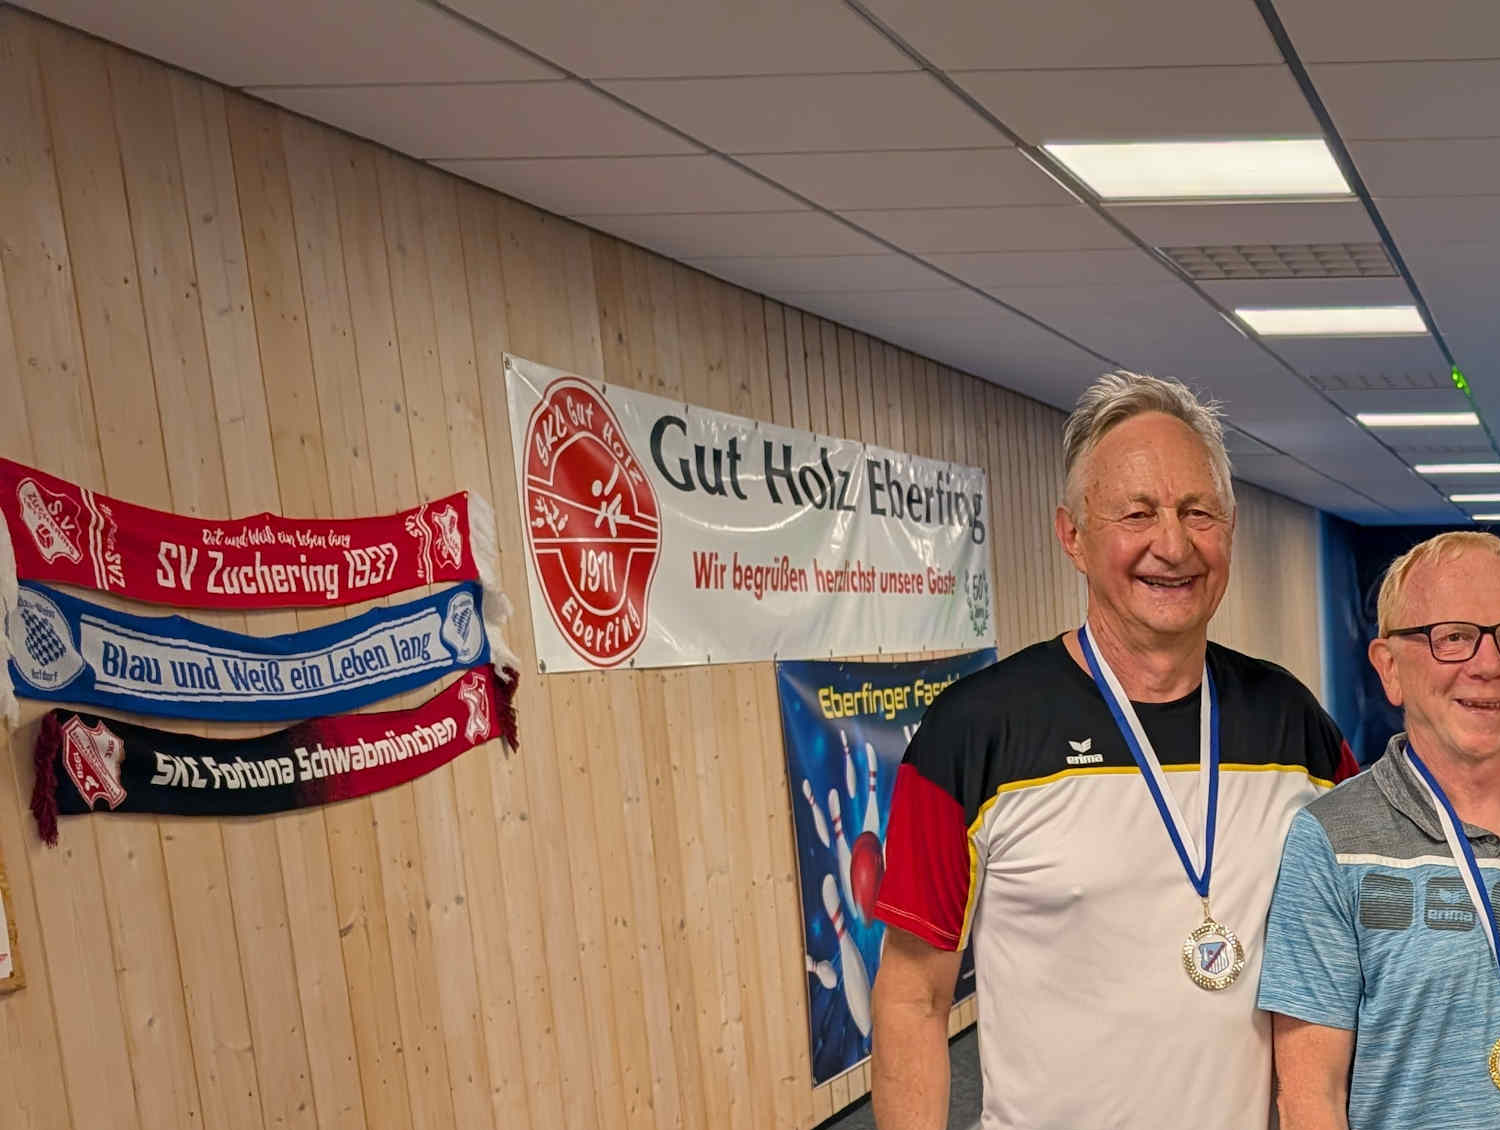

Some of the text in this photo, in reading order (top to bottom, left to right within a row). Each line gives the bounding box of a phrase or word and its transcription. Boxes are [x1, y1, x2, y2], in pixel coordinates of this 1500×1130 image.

[536, 395, 643, 485] SKC Gut Holz
[650, 415, 985, 545] Gut Holz Eberfing
[105, 551, 126, 588] SVZ
[157, 541, 198, 590] SV
[207, 550, 339, 600] Zuchering
[343, 542, 398, 589] 1937
[580, 548, 617, 592] 1971
[693, 551, 727, 590] Wir
[733, 552, 808, 600] begrüßen
[814, 558, 875, 594] herzlichst
[880, 571, 923, 595] unsere
[561, 597, 641, 653] Eberfing
[102, 632, 431, 692] Blau und Weiß ein Leben lang
[818, 682, 910, 720] Eberfinger
[203, 755, 295, 790] Fortuna
[295, 716, 458, 781] Schwabmünchen
[1066, 753, 1104, 765] erima
